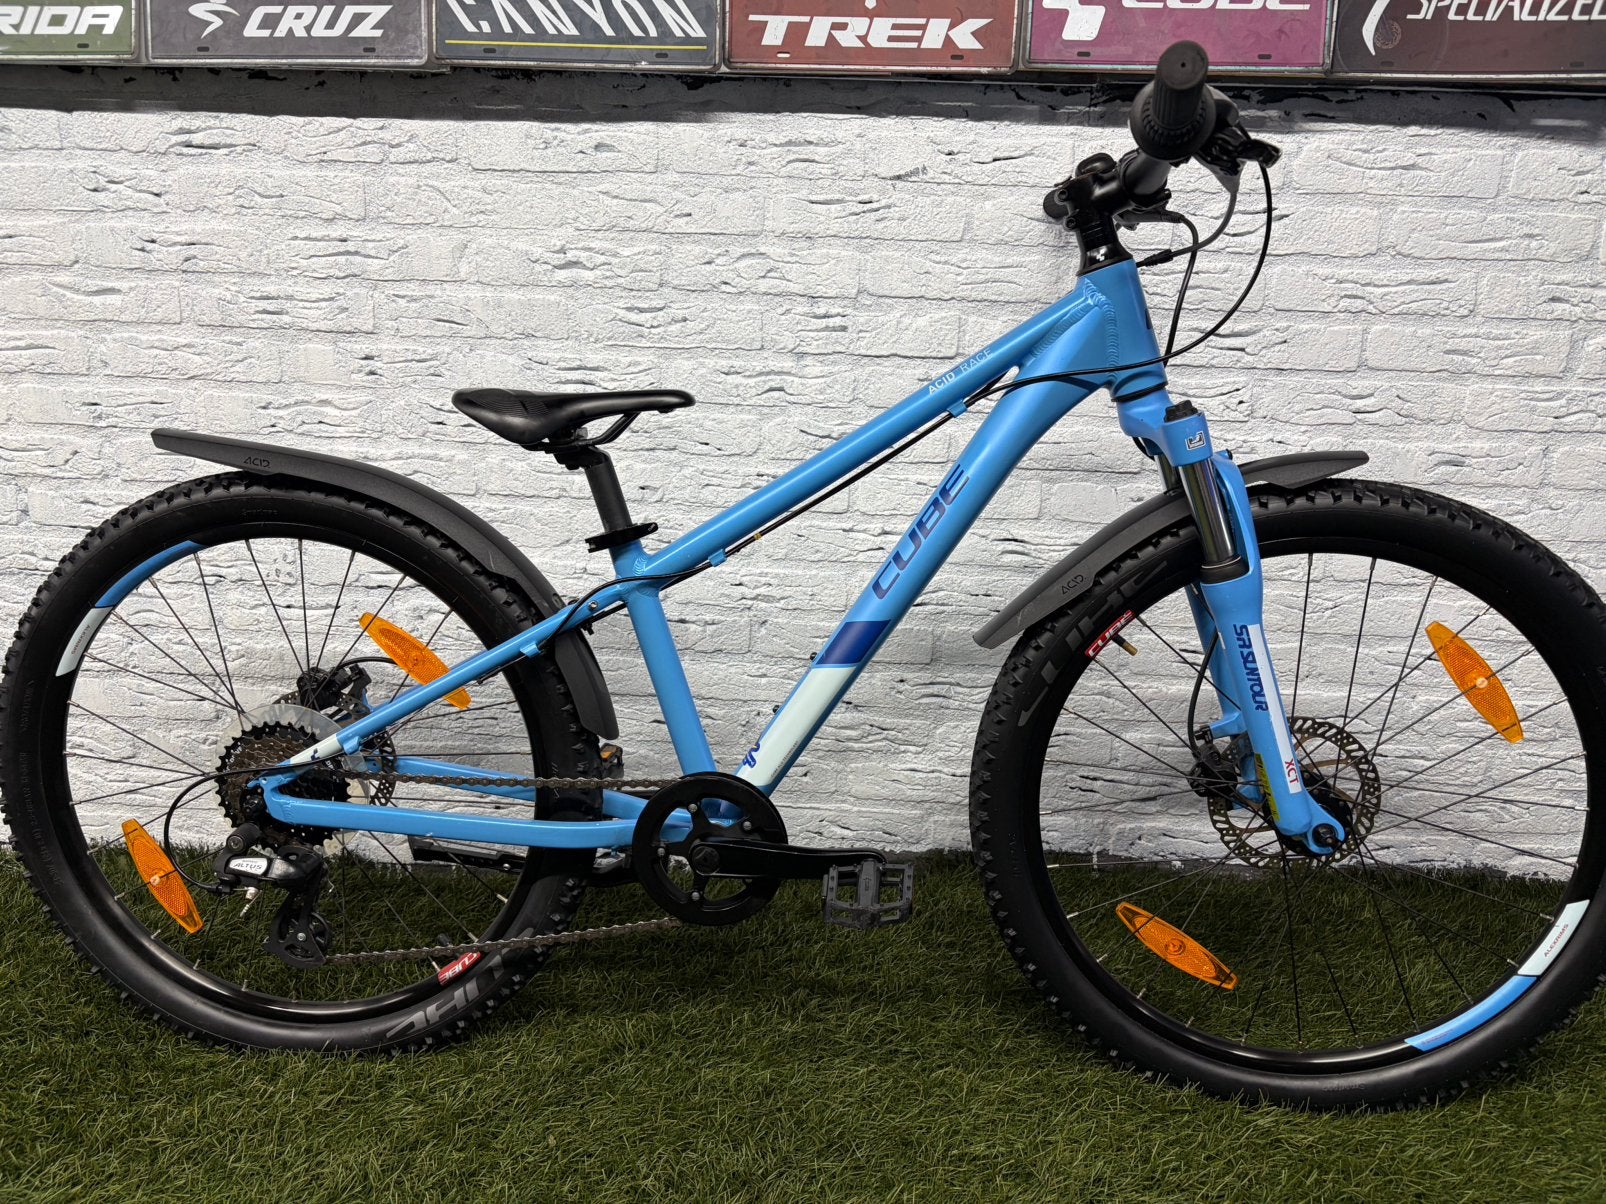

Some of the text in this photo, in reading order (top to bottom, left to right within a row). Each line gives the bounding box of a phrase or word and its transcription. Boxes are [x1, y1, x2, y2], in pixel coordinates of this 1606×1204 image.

[243, 4, 394, 38] CRUZ
[748, 14, 994, 50] TREK
[928, 347, 993, 396] ACID RACE
[871, 463, 970, 600] CUBE
[1240, 648, 1269, 712] SUNTOUR
[1284, 757, 1299, 785] XCT
